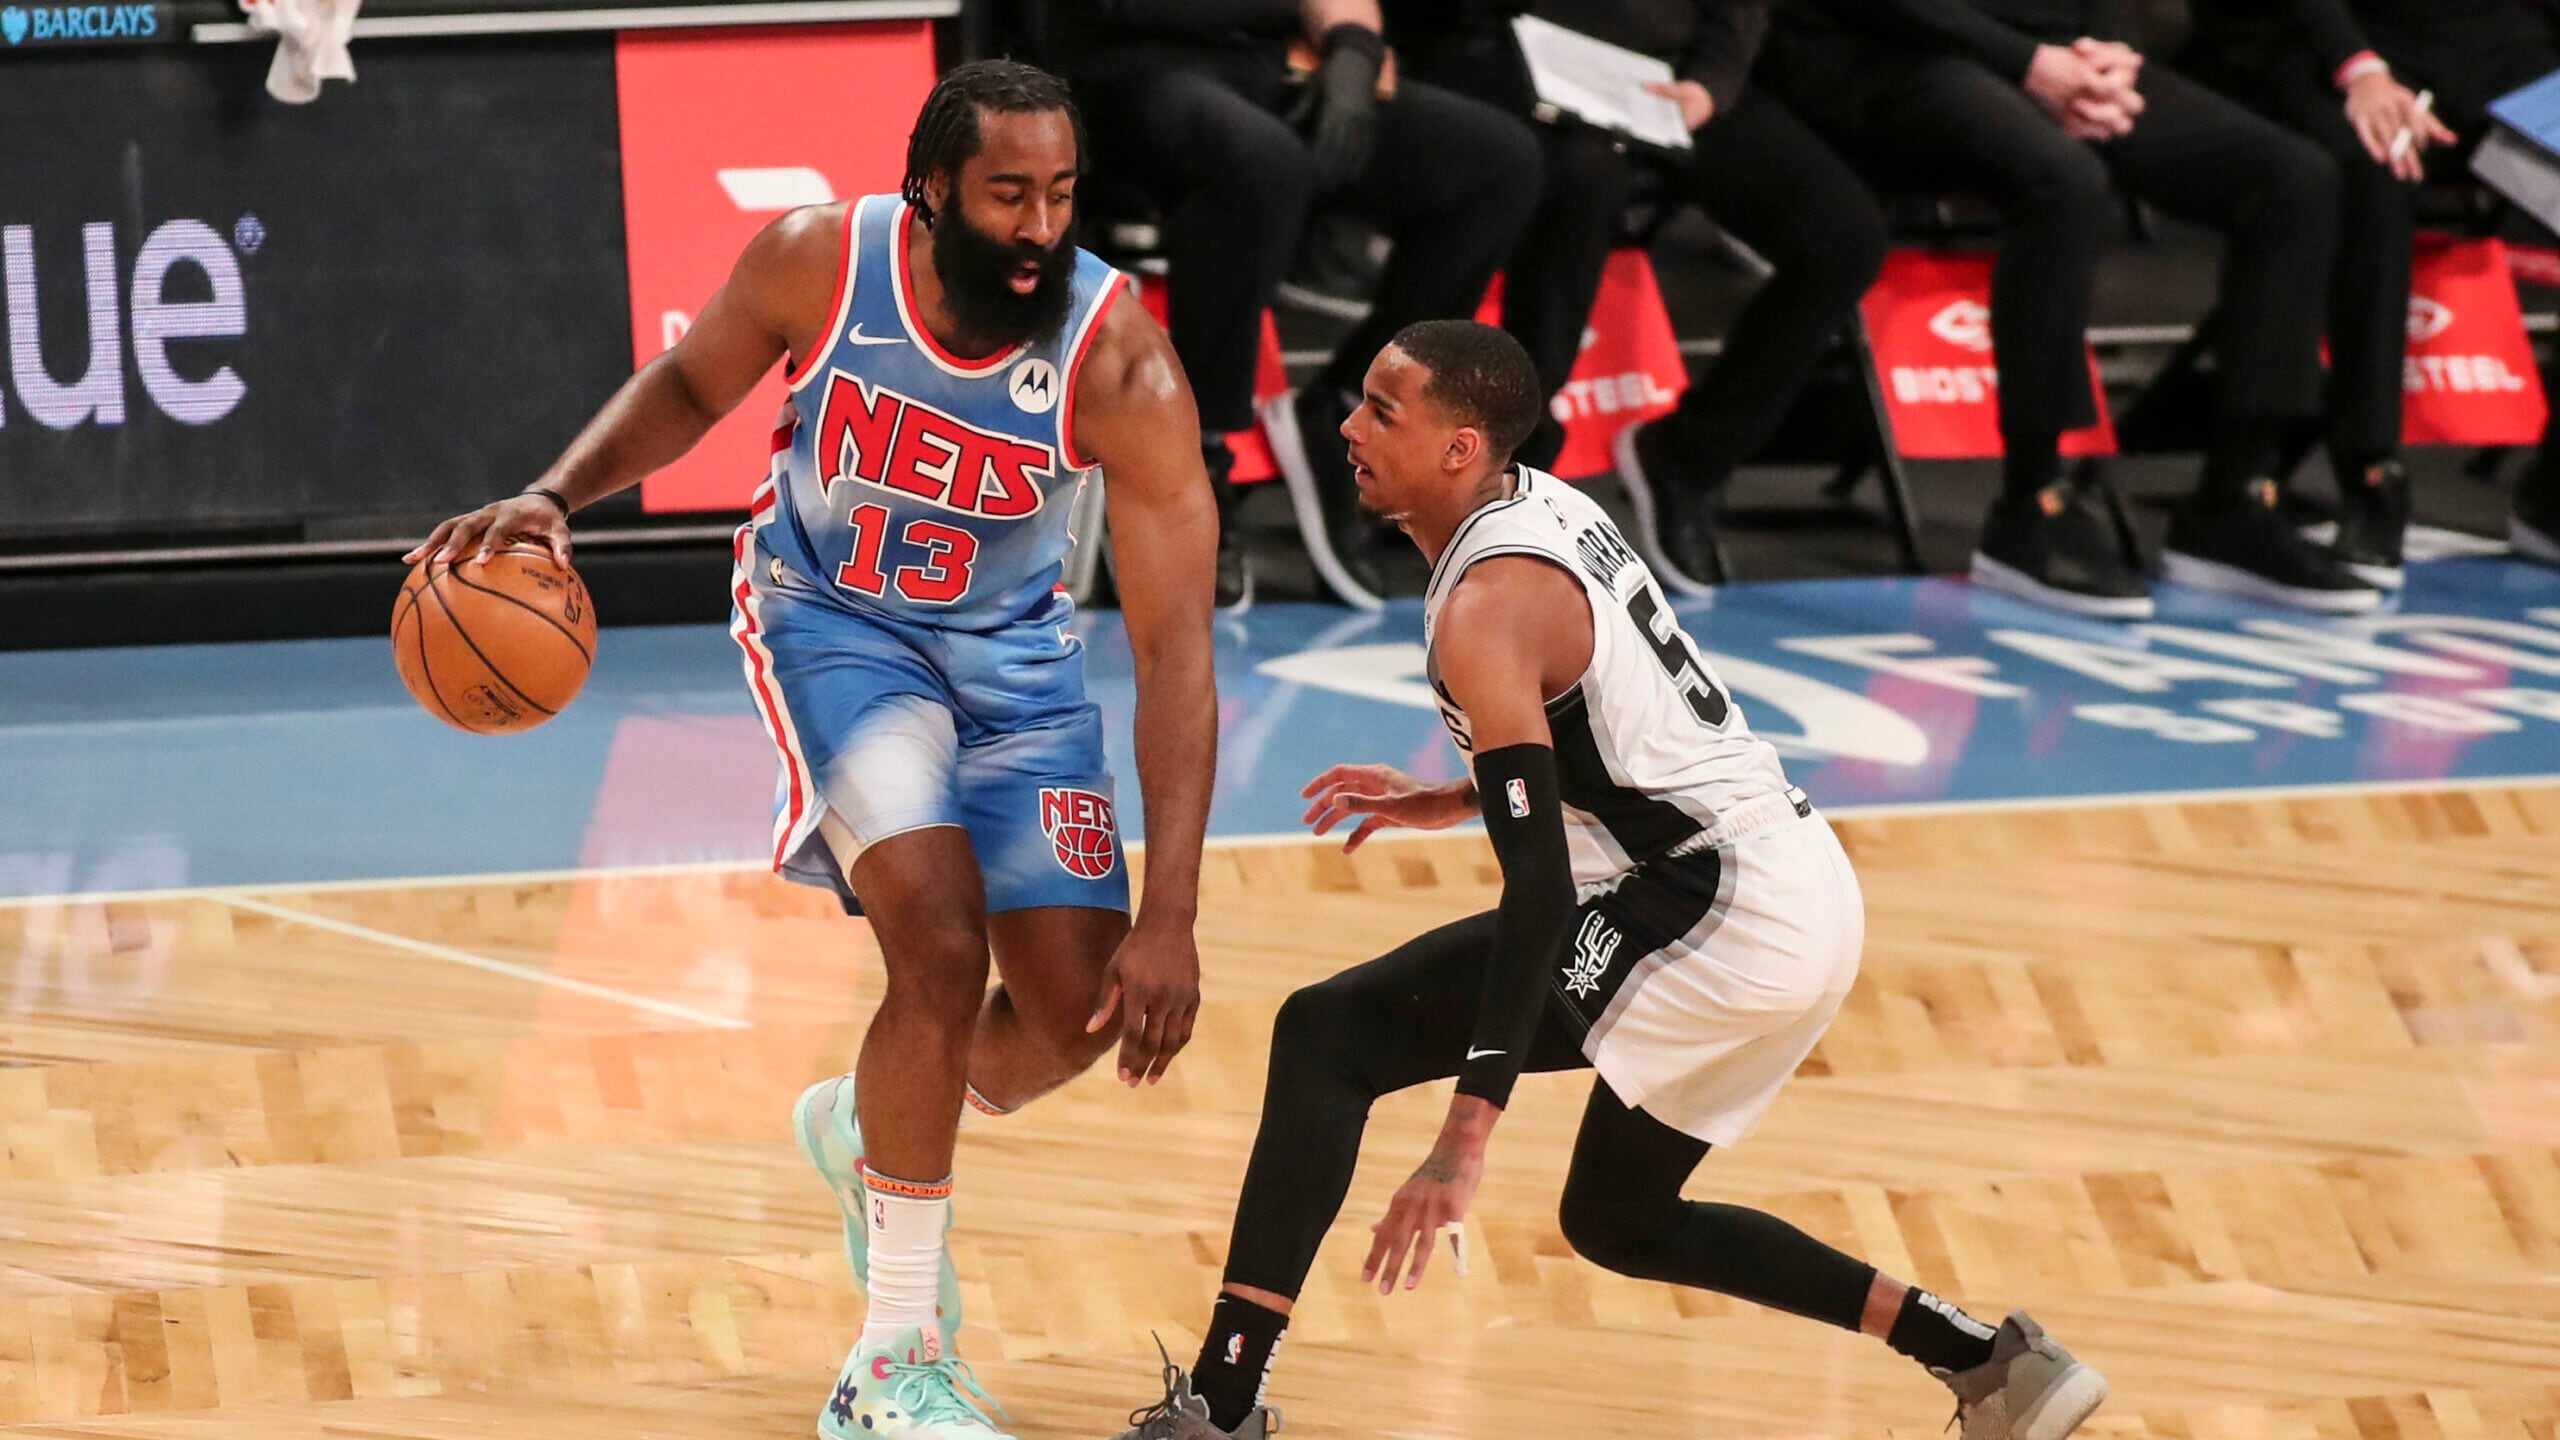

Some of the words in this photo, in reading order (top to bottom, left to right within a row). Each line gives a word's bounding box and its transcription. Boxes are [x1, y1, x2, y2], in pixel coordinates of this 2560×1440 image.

[32, 4, 157, 39] BARCLAYS
[0, 218, 248, 431] ue
[814, 366, 1056, 521] NETS
[835, 501, 980, 605] 13
[1576, 520, 1638, 603] MURRAY
[1625, 572, 1733, 735] 5
[1039, 788, 1114, 840] NETS
[867, 1177, 953, 1196] THENTICS
